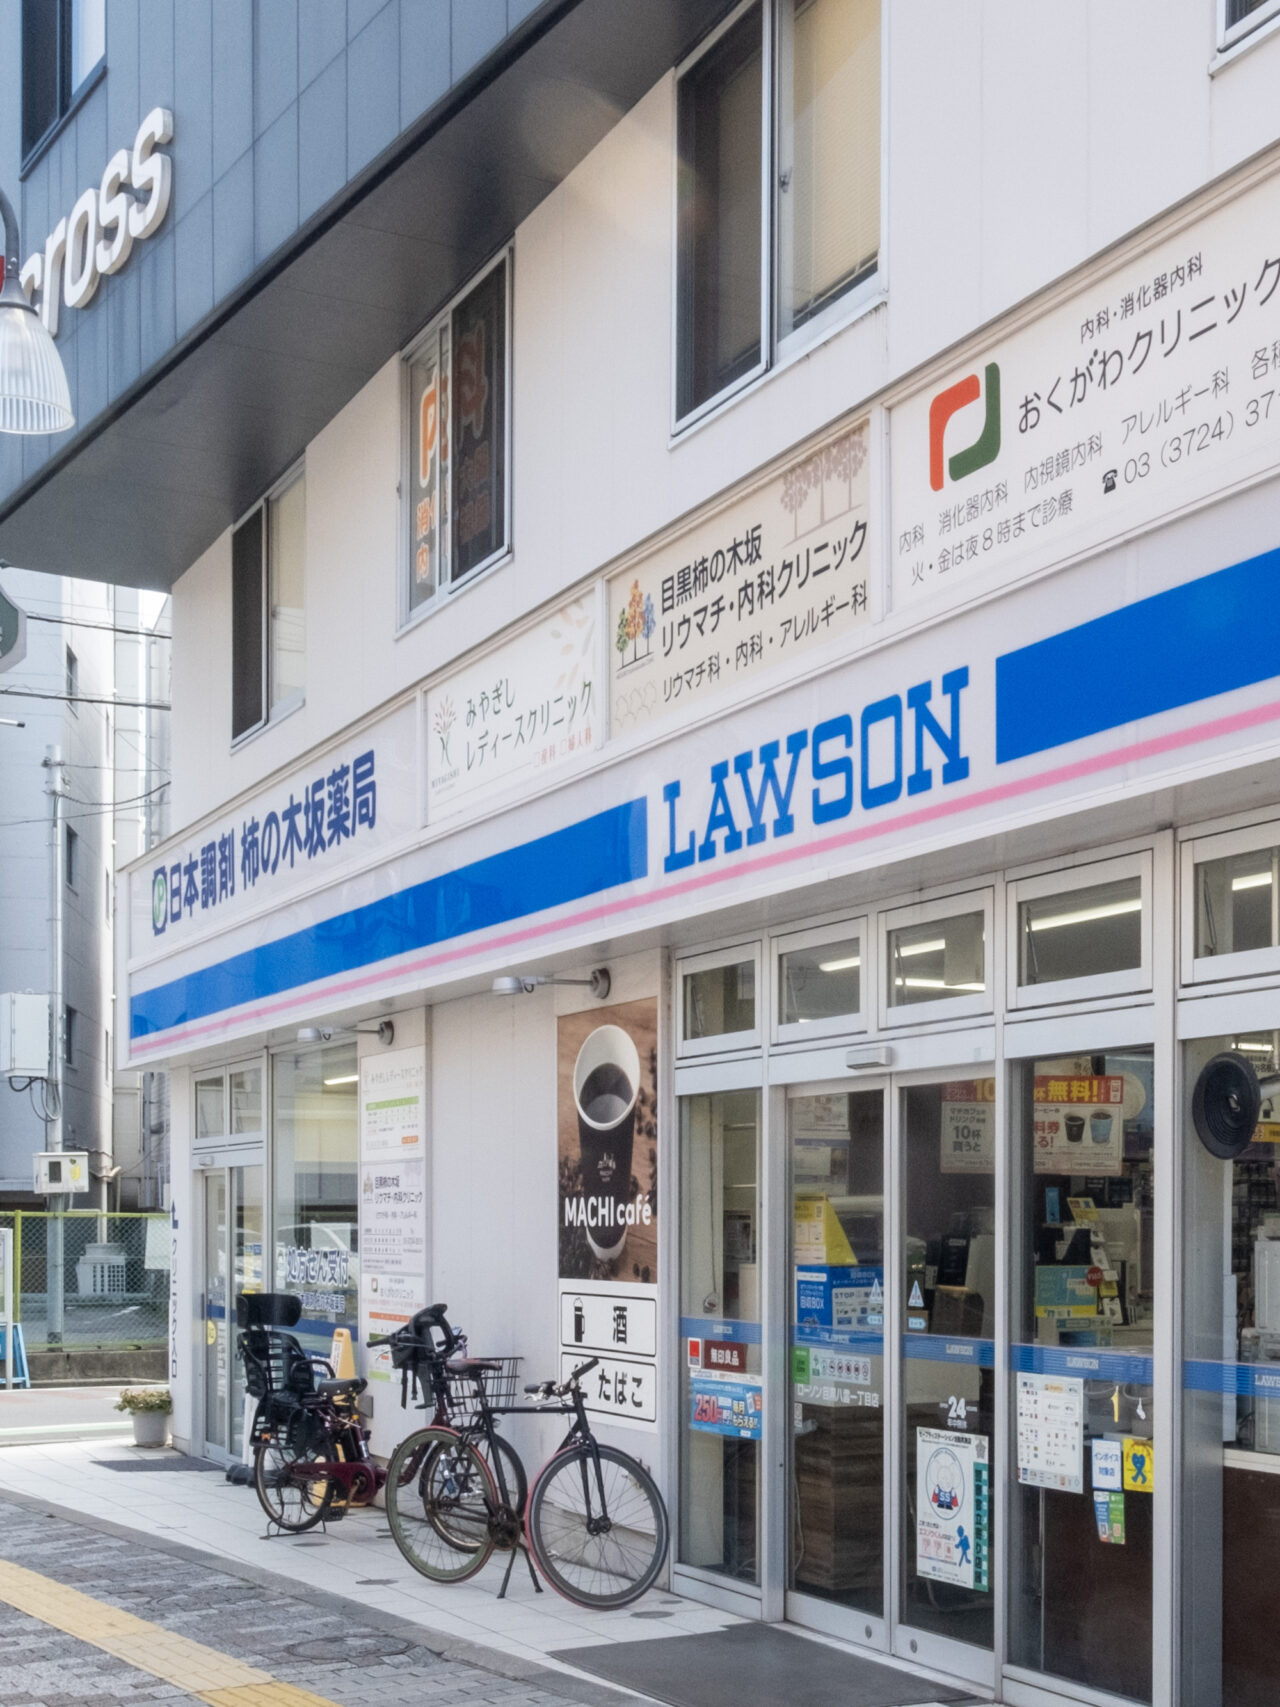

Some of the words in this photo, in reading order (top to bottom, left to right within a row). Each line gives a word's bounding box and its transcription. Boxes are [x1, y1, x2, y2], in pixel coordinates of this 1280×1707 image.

[1080, 252, 1203, 344] 内科・消化器内科
[899, 523, 924, 555] 内科
[938, 480, 1008, 536] 消化器内科
[1121, 366, 1230, 445] アレルギー科
[1124, 451, 1150, 484] 03
[1160, 410, 1234, 467] (3724)
[662, 524, 762, 615] 目黒柿の木坂
[662, 520, 867, 657] リウマチ・内科クリニック
[466, 678, 515, 727] みやぎし
[467, 681, 592, 771] レディースクリニック
[663, 665, 969, 873] LAWSON
[169, 828, 235, 923] 日本調剤
[241, 750, 376, 891] 柿の木坂薬局
[564, 1196, 615, 1228] MACHI
[617, 1194, 651, 1227] café
[287, 1246, 350, 1288] 処方せん受付
[613, 1306, 627, 1344] 酒
[598, 1368, 643, 1408] たばこ
[948, 1395, 967, 1419] 24
